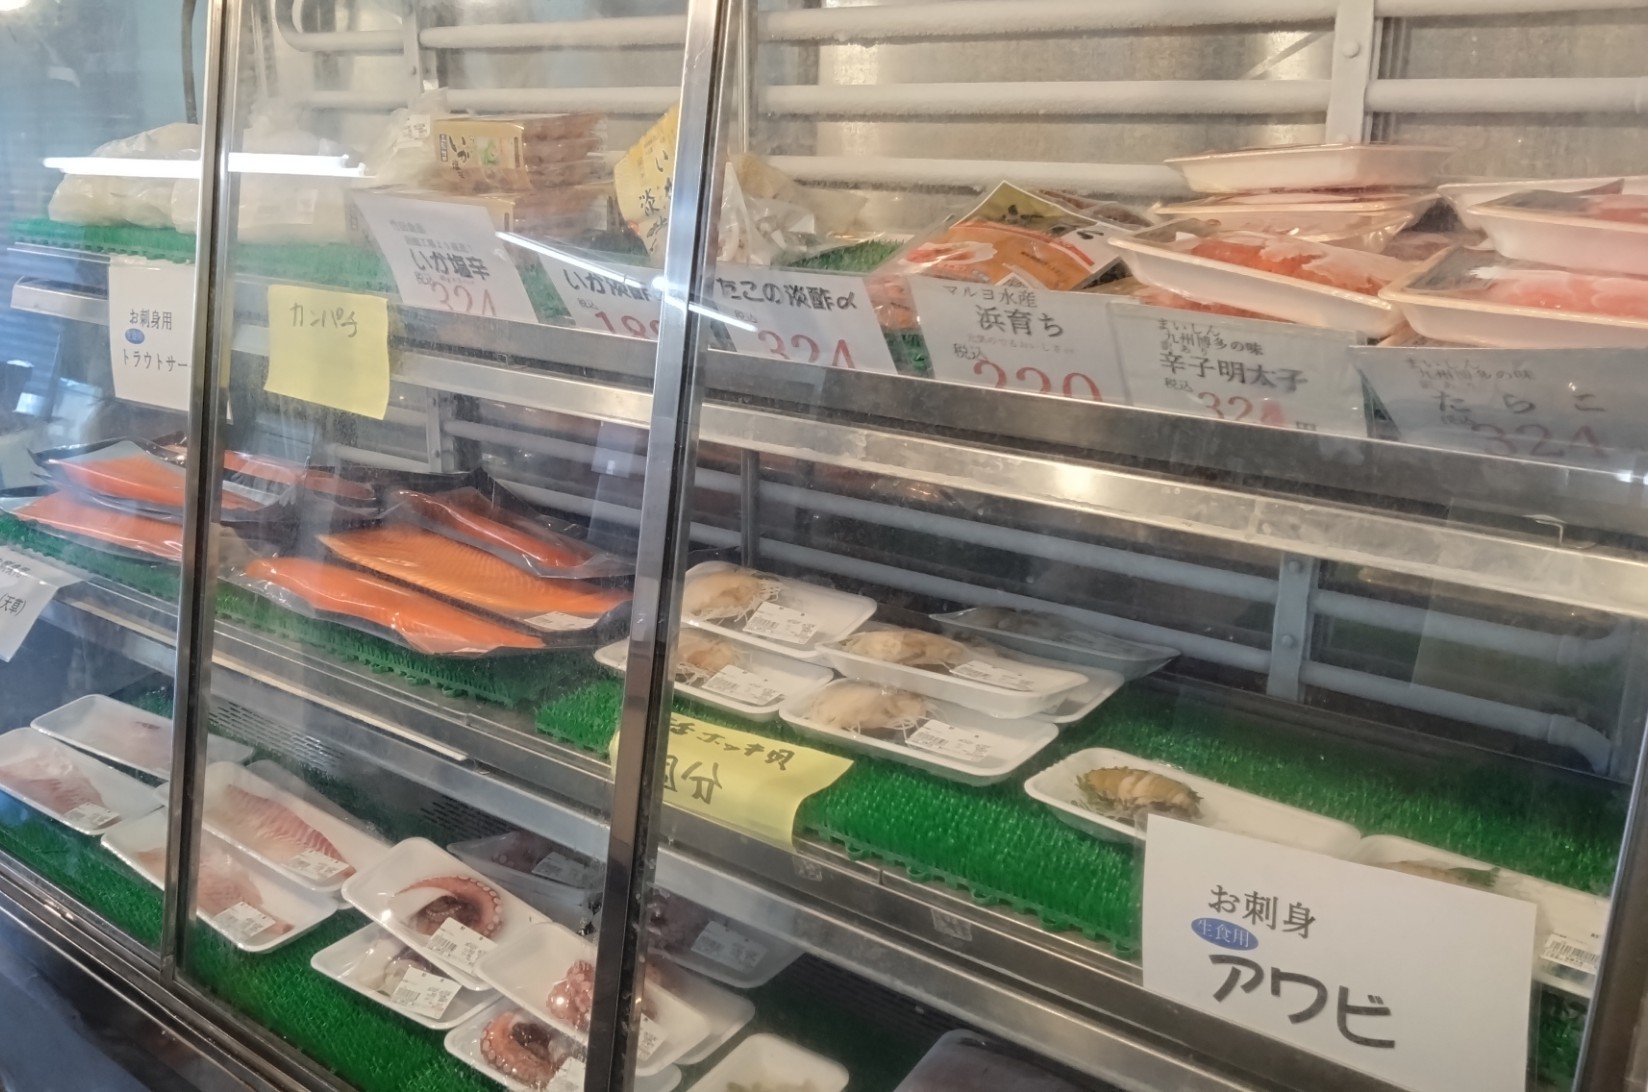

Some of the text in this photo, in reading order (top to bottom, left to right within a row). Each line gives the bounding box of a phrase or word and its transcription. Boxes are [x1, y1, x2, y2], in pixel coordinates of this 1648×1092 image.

[942, 284, 1039, 308] マルヨ水産
[128, 308, 173, 331] お刺身用
[975, 303, 1065, 338] 浜育ち
[1159, 351, 1309, 394] 辛子明太子
[1207, 883, 1319, 942] お刺身
[1196, 917, 1254, 951] 生食用
[1207, 953, 1397, 1051] アワビ
